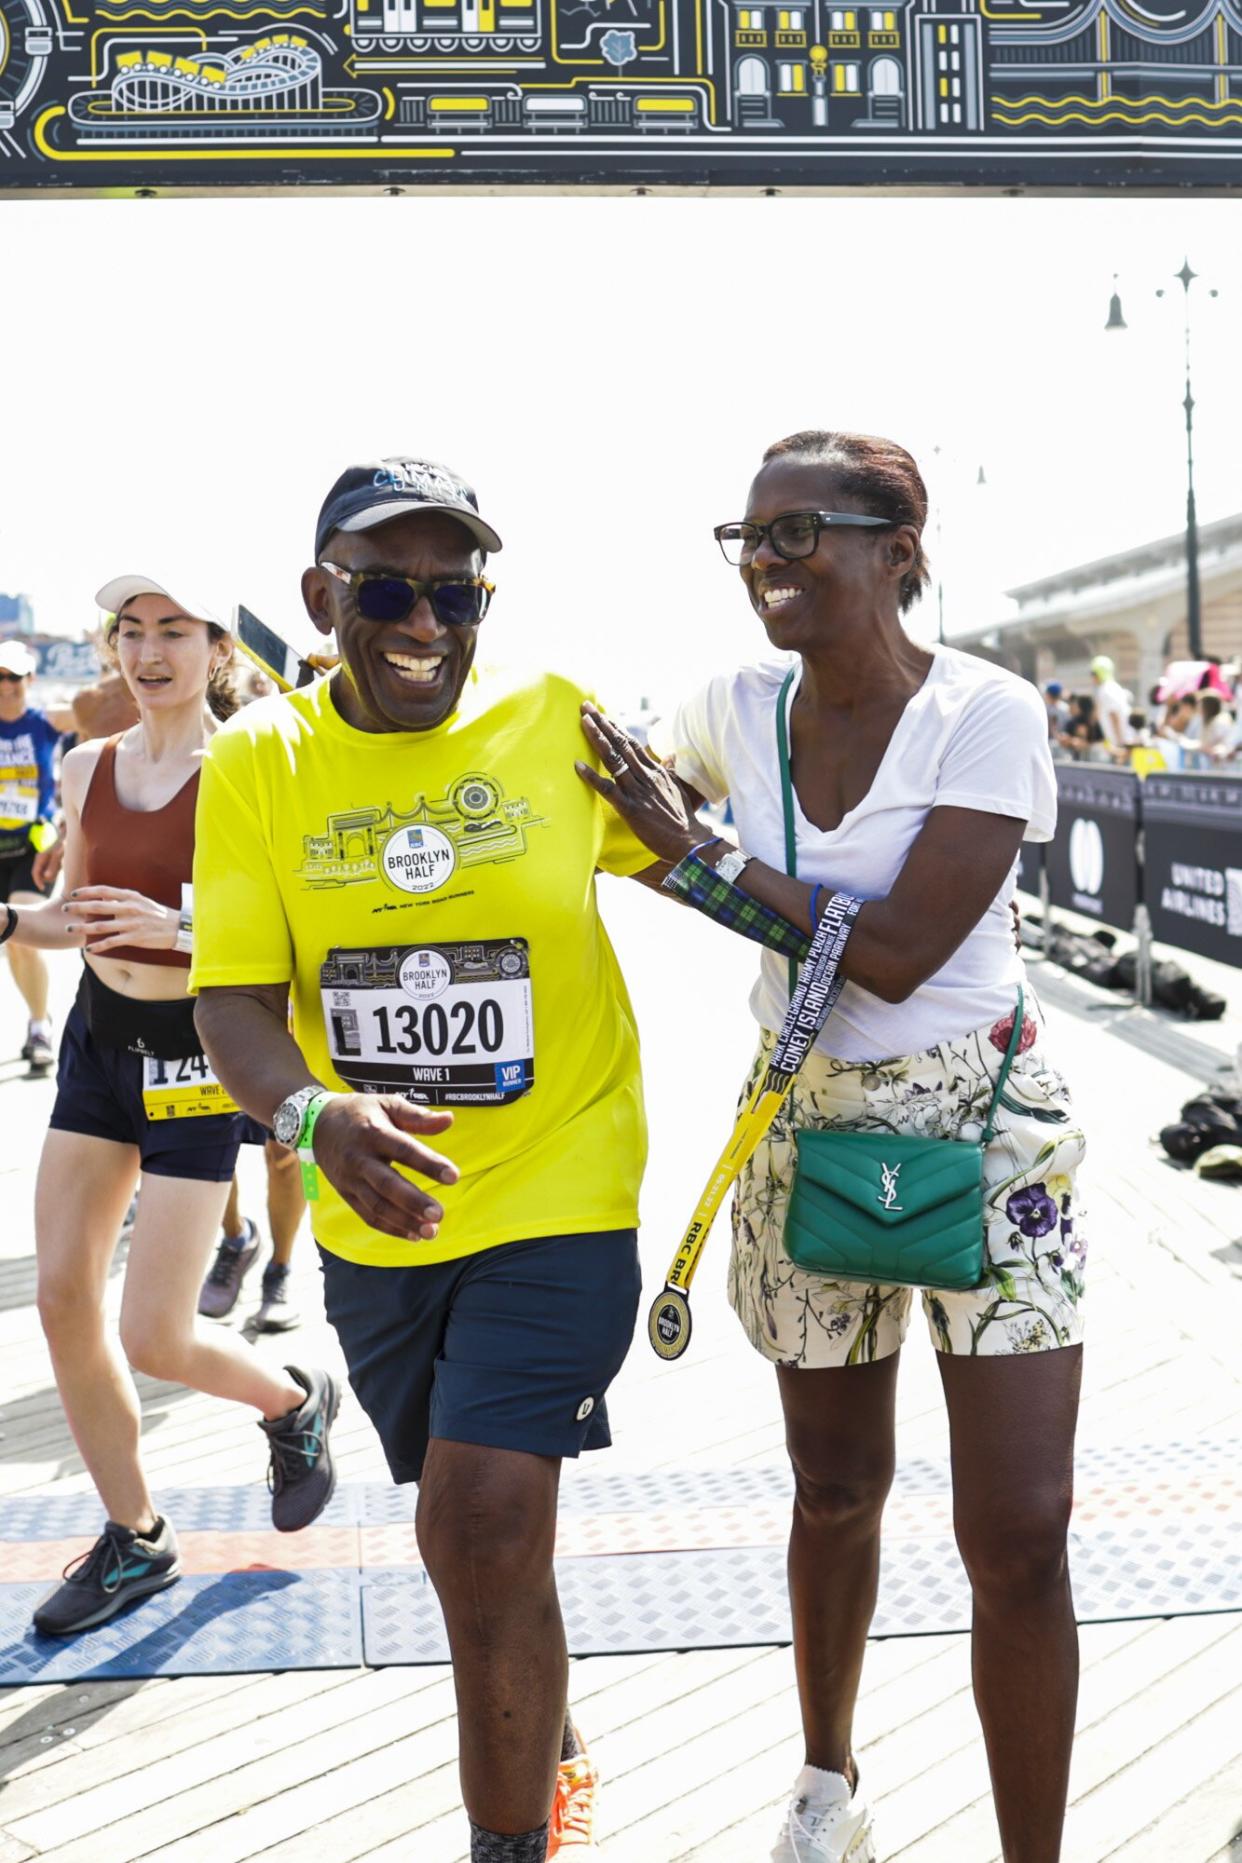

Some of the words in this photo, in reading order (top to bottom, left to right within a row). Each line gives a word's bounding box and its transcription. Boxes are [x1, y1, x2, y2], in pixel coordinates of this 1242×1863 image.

[388, 849, 450, 869] BROOKLYN
[405, 864, 435, 880] HALF
[1171, 862, 1225, 896] UNITED
[1161, 886, 1226, 927] AIRLINES
[820, 959, 838, 986] OCEAN
[829, 922, 852, 960] PARKWAY
[403, 969, 447, 981] BROOKLYN
[415, 979, 436, 990] HALF
[372, 999, 504, 1056] 13020
[770, 1042, 786, 1067] PARK
[779, 1012, 797, 1043] CIRCLE
[780, 1028, 810, 1073] CONEY
[797, 981, 829, 1030] ISLAND
[413, 1067, 443, 1081] WAVE
[445, 1068, 450, 1081] 1
[501, 1065, 521, 1080] VIP
[200, 1085, 220, 1097] WAVE
[877, 1162, 903, 1210] YSL
[681, 1221, 702, 1255] RBC
[670, 1258, 687, 1286] BR
